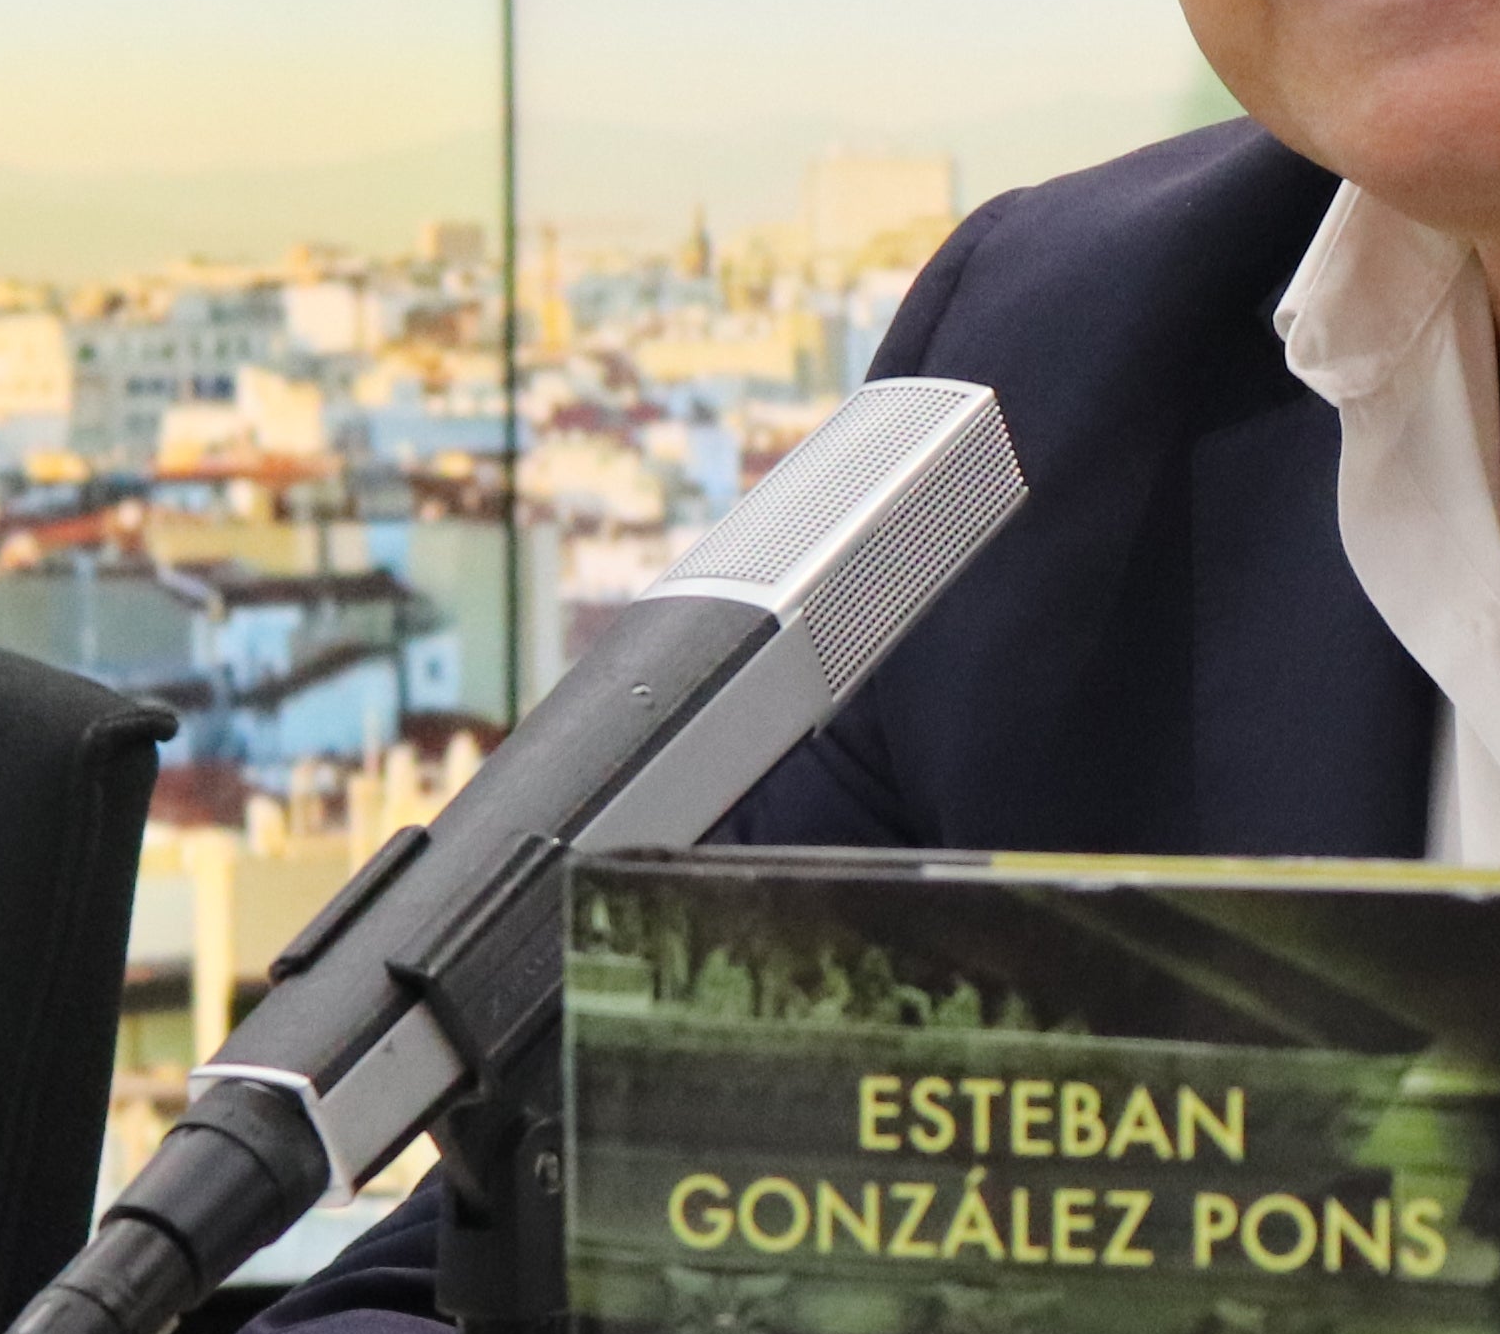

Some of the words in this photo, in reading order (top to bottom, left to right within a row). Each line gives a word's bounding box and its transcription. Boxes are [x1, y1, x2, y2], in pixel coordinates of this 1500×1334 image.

[858, 1076, 1245, 1162] ESTEBAN
[668, 1168, 1154, 1267] GONZÁLEZ
[1194, 1194, 1448, 1275] PONS
